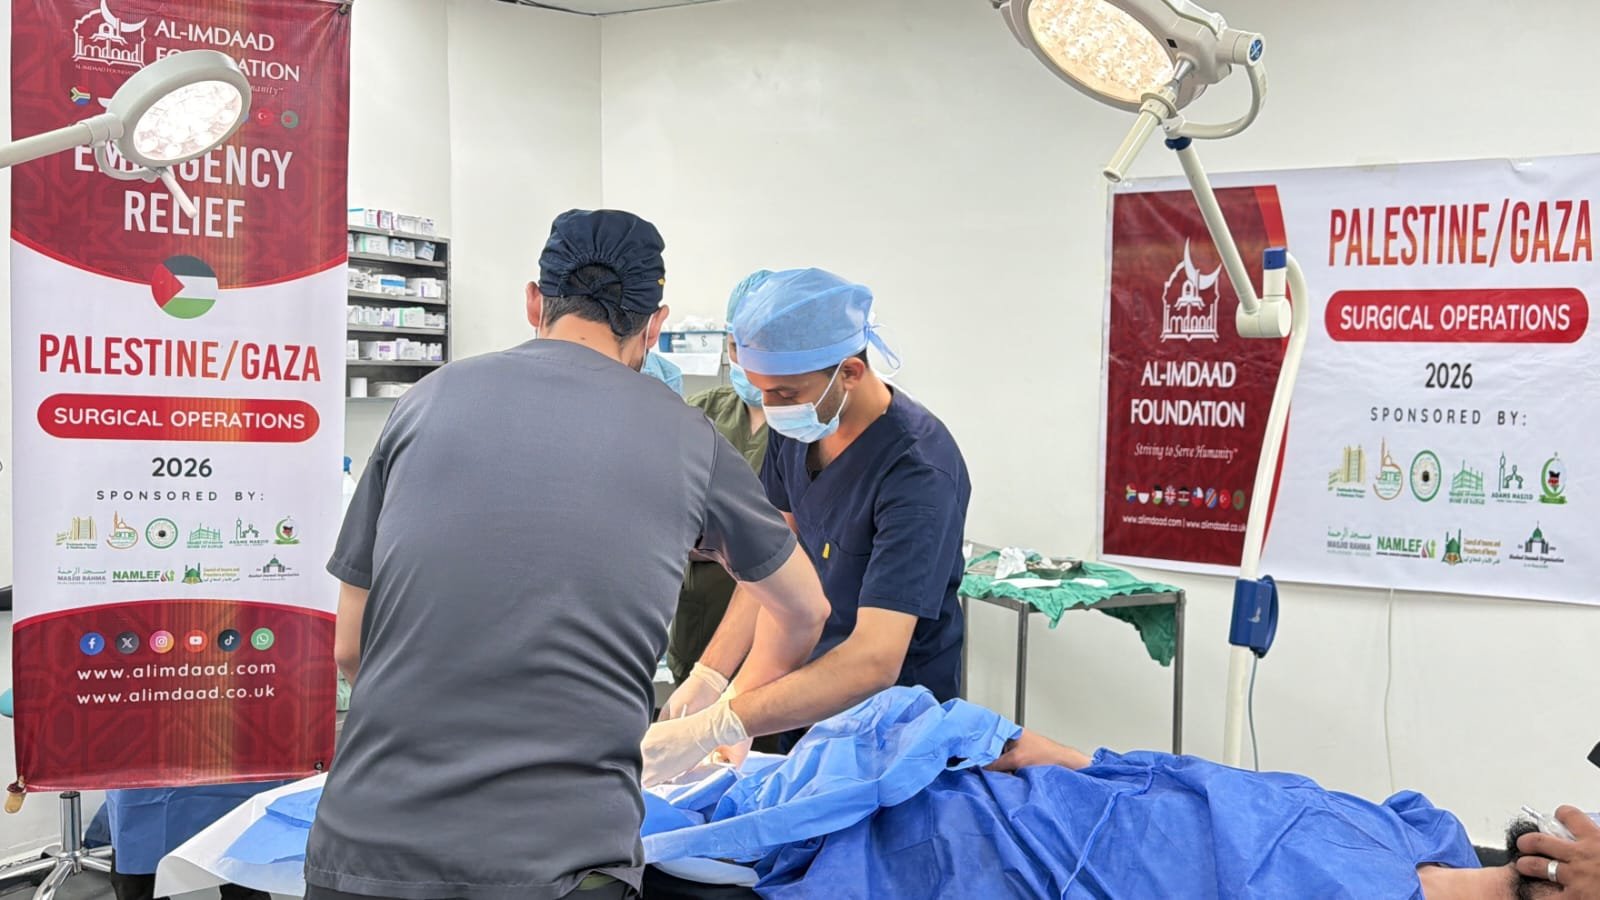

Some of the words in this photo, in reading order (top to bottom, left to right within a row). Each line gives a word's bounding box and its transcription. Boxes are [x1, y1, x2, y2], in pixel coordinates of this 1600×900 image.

[154, 19, 275, 52] AL-IMDAAD
[155, 46, 300, 82] FATION
[124, 189, 246, 239] RELIEF
[1328, 198, 1594, 268] PALESTINE/GAZA
[1340, 304, 1434, 331] SURGICAL
[1440, 304, 1571, 331] OPERATIONS
[38, 333, 322, 382] PALESTINE/GAZA
[1140, 360, 1237, 388] AL-IMDAAD
[1425, 362, 1474, 390] 2026
[53, 406, 163, 428] SURGICAL
[170, 410, 305, 430] OPERATIONS
[1130, 398, 1246, 428] FOUNDATION
[1370, 407, 1482, 425] SPONSORED
[1497, 411, 1528, 427] BY:
[151, 457, 213, 478] 2026
[96, 490, 219, 502] SPONSORED
[234, 491, 265, 502] BY:
[1376, 535, 1422, 553] NAMLEF
[112, 570, 160, 580] NAMLEF
[77, 661, 276, 681] www.alimdaad.com
[77, 684, 275, 705] www.alimdaad.co.uk
